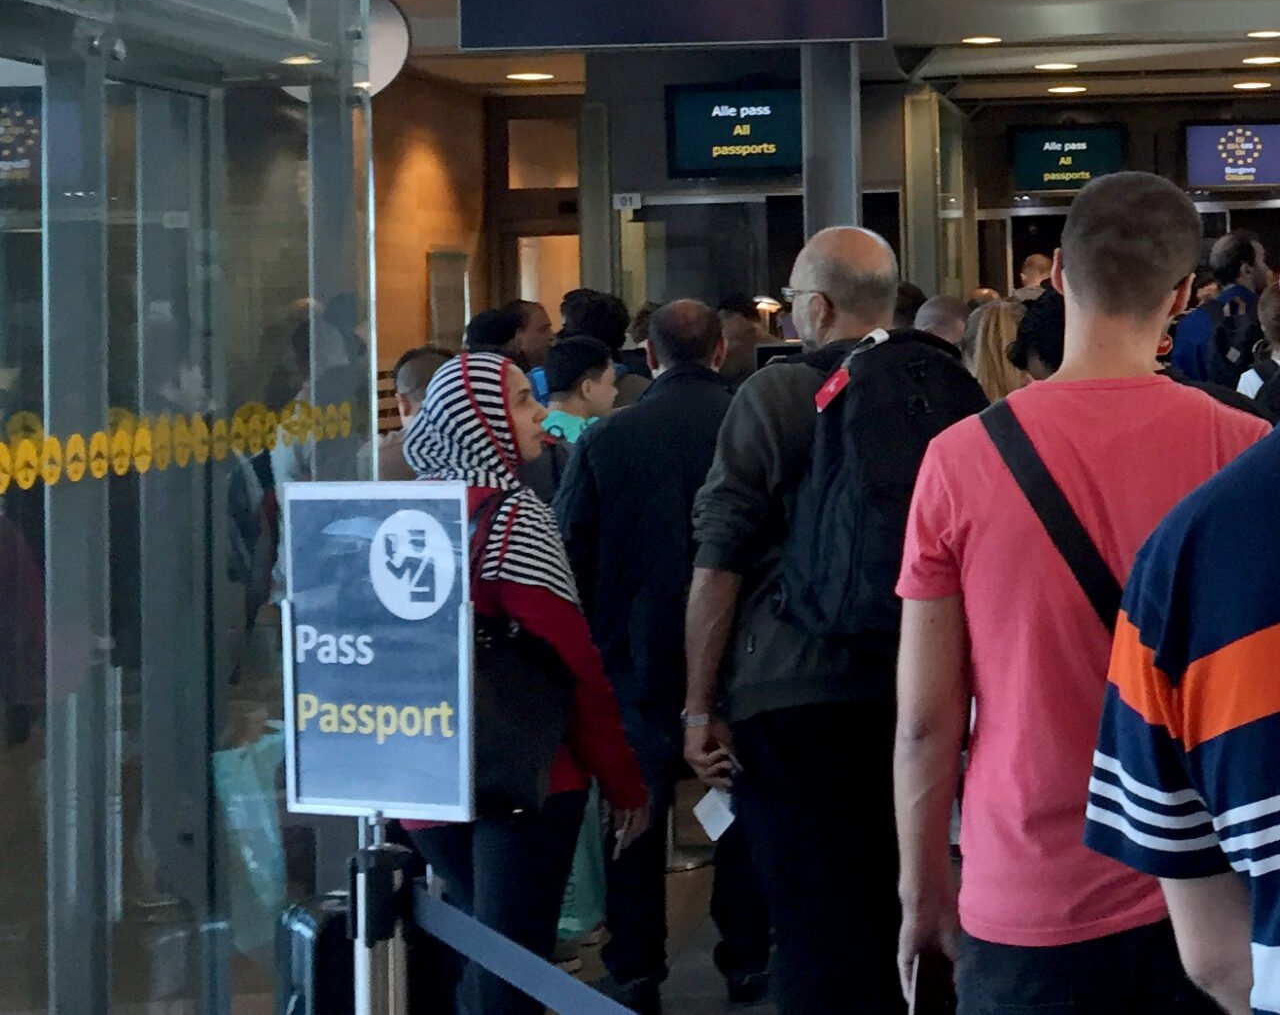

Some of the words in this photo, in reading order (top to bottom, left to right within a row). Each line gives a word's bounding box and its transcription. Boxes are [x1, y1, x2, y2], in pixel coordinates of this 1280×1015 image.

[711, 105, 737, 117] Alle
[739, 105, 772, 118] pass
[732, 124, 751, 136] All
[711, 143, 777, 158] passports
[295, 624, 375, 665] Pass
[297, 693, 454, 744] Passport
